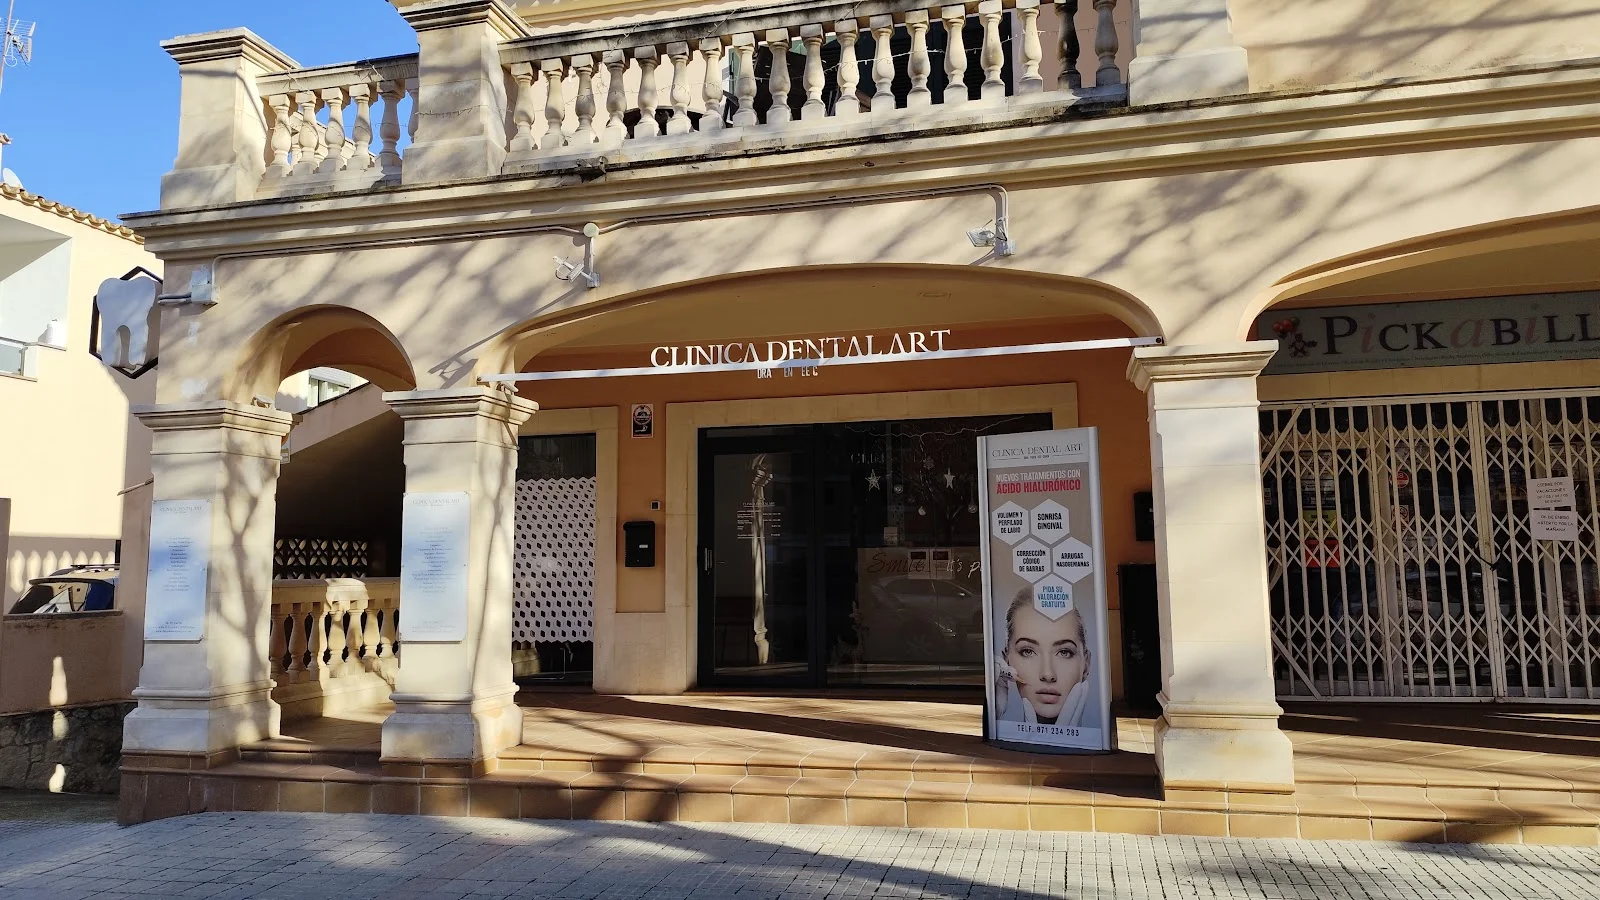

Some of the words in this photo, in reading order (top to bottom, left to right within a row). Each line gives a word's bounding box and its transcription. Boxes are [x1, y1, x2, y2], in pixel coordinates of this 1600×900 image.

[650, 343, 759, 368] CLINICA
[766, 335, 883, 362] DENTAL
[889, 329, 951, 355] ART
[992, 448, 1025, 458] CLINICA
[1027, 445, 1061, 455] DENTAL
[1064, 443, 1083, 452] ART
[995, 473, 1019, 482] NUEVOS
[1020, 470, 1066, 481] TRATAMIENTOS
[1067, 469, 1081, 479] CON
[996, 482, 1021, 495] ÁCIDO
[1023, 477, 1081, 493] HIALURÓNICO
[997, 511, 1018, 519] VOLUMEN
[1037, 512, 1062, 521] SONRISA
[1007, 526, 1021, 534] LABIO
[1037, 521, 1063, 530] GINGIVAL
[1016, 549, 1046, 557] CORRECCIÓN
[1061, 552, 1084, 560] ARRUGAS
[1022, 556, 1041, 564] CÓDIGO
[1042, 585, 1055, 593] PIDA
[1055, 585, 1063, 593] SU
[1037, 592, 1069, 601] VALORACIÓN
[1041, 600, 1066, 608] GRATUITA
[1051, 727, 1064, 735] 234
[1066, 728, 1080, 737] 283
